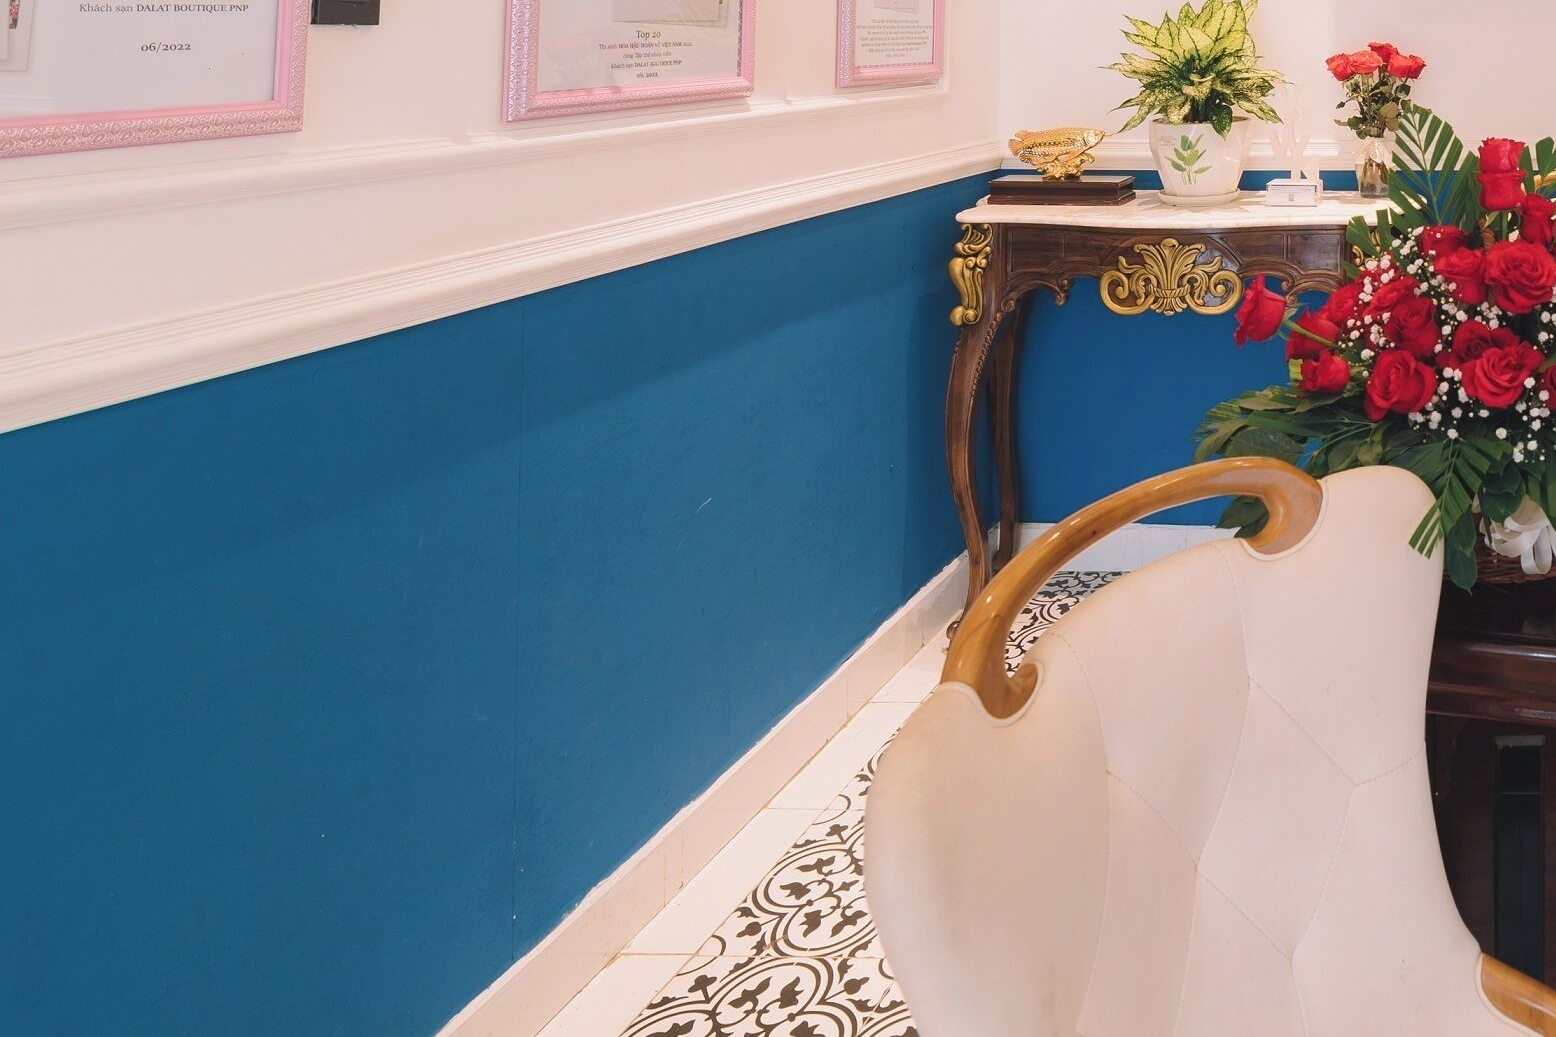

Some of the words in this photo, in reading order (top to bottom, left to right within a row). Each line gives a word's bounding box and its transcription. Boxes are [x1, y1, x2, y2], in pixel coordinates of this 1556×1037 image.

[79, 2, 111, 13] Khách
[115, 5, 133, 15] sạn
[136, 3, 170, 12] DALAT
[174, 3, 227, 14] BOUTIQUE
[229, 4, 249, 12] PNP
[636, 30, 650, 41] Top
[140, 41, 191, 53] 06/2022
